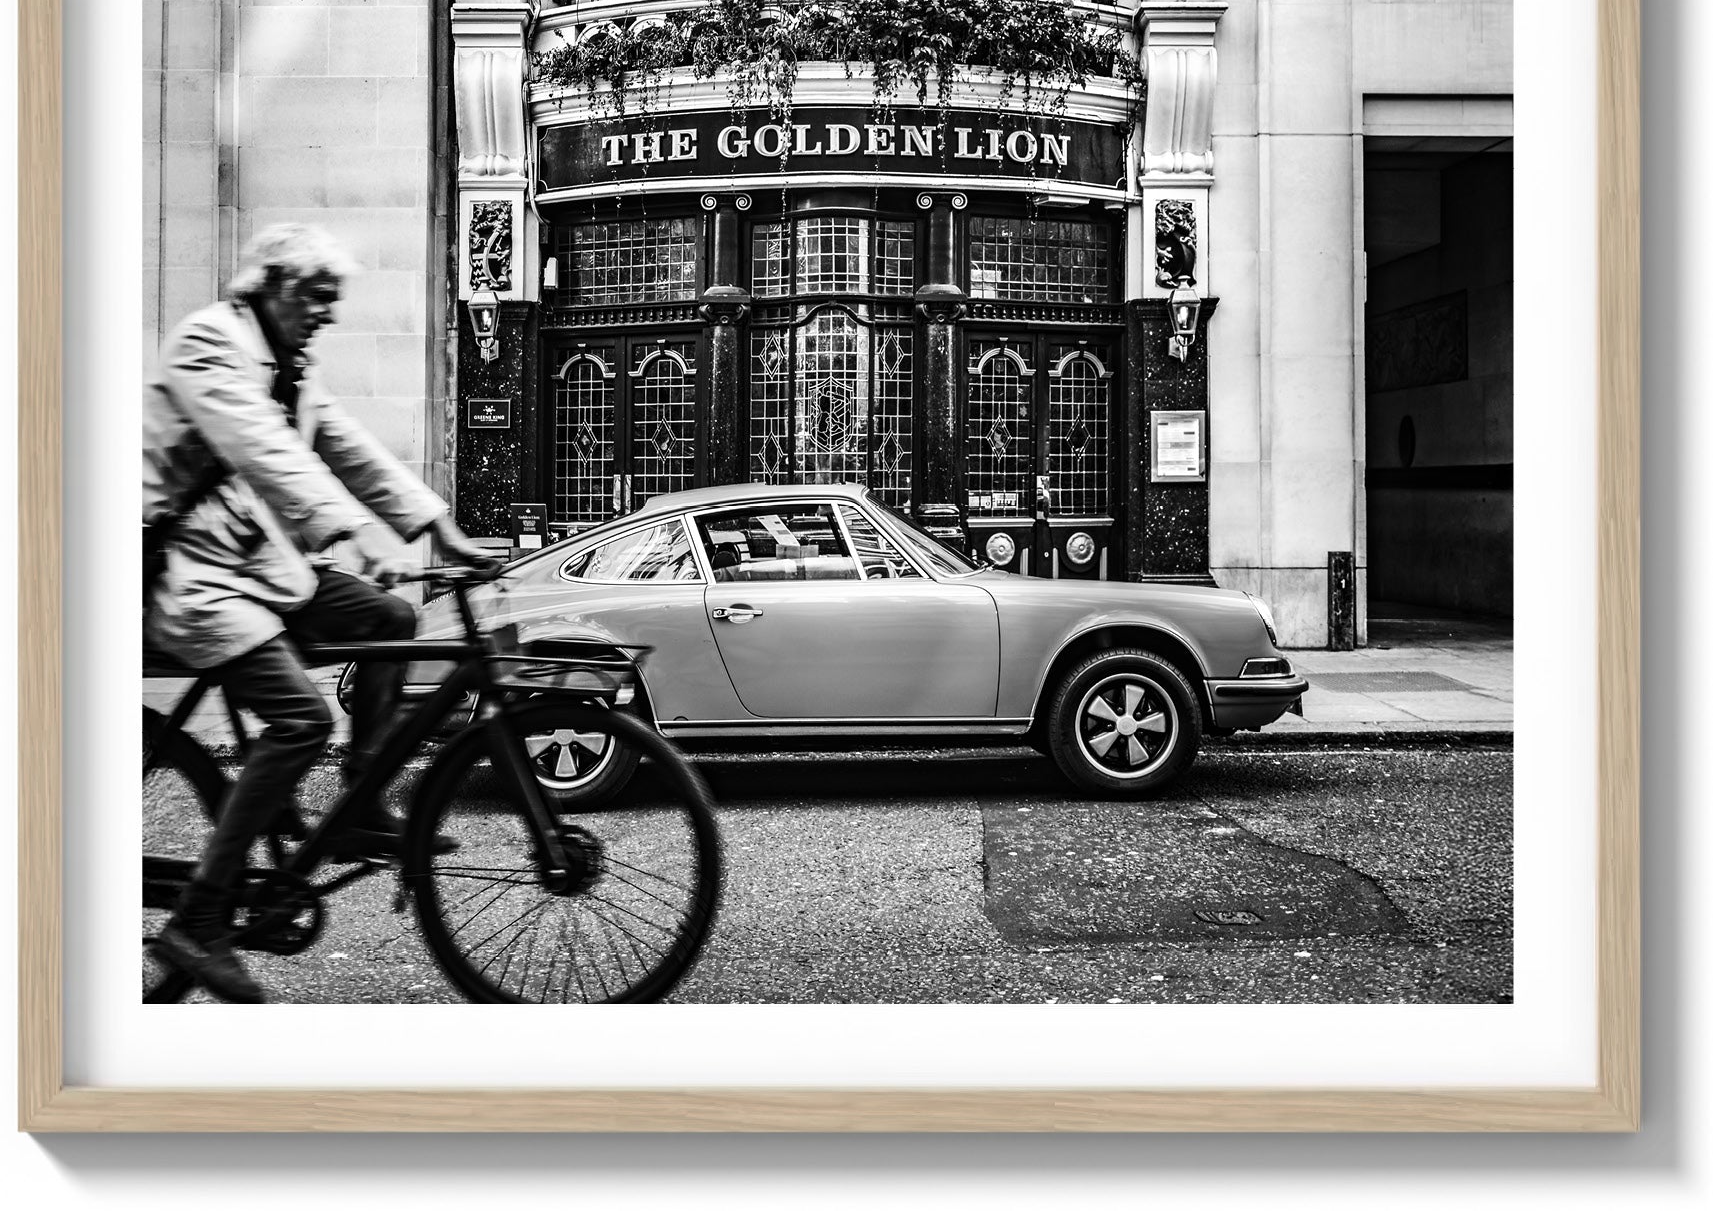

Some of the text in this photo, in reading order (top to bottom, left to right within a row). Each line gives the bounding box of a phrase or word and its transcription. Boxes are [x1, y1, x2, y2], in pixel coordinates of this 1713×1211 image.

[602, 124, 1071, 166] THE GOLDEN LION
